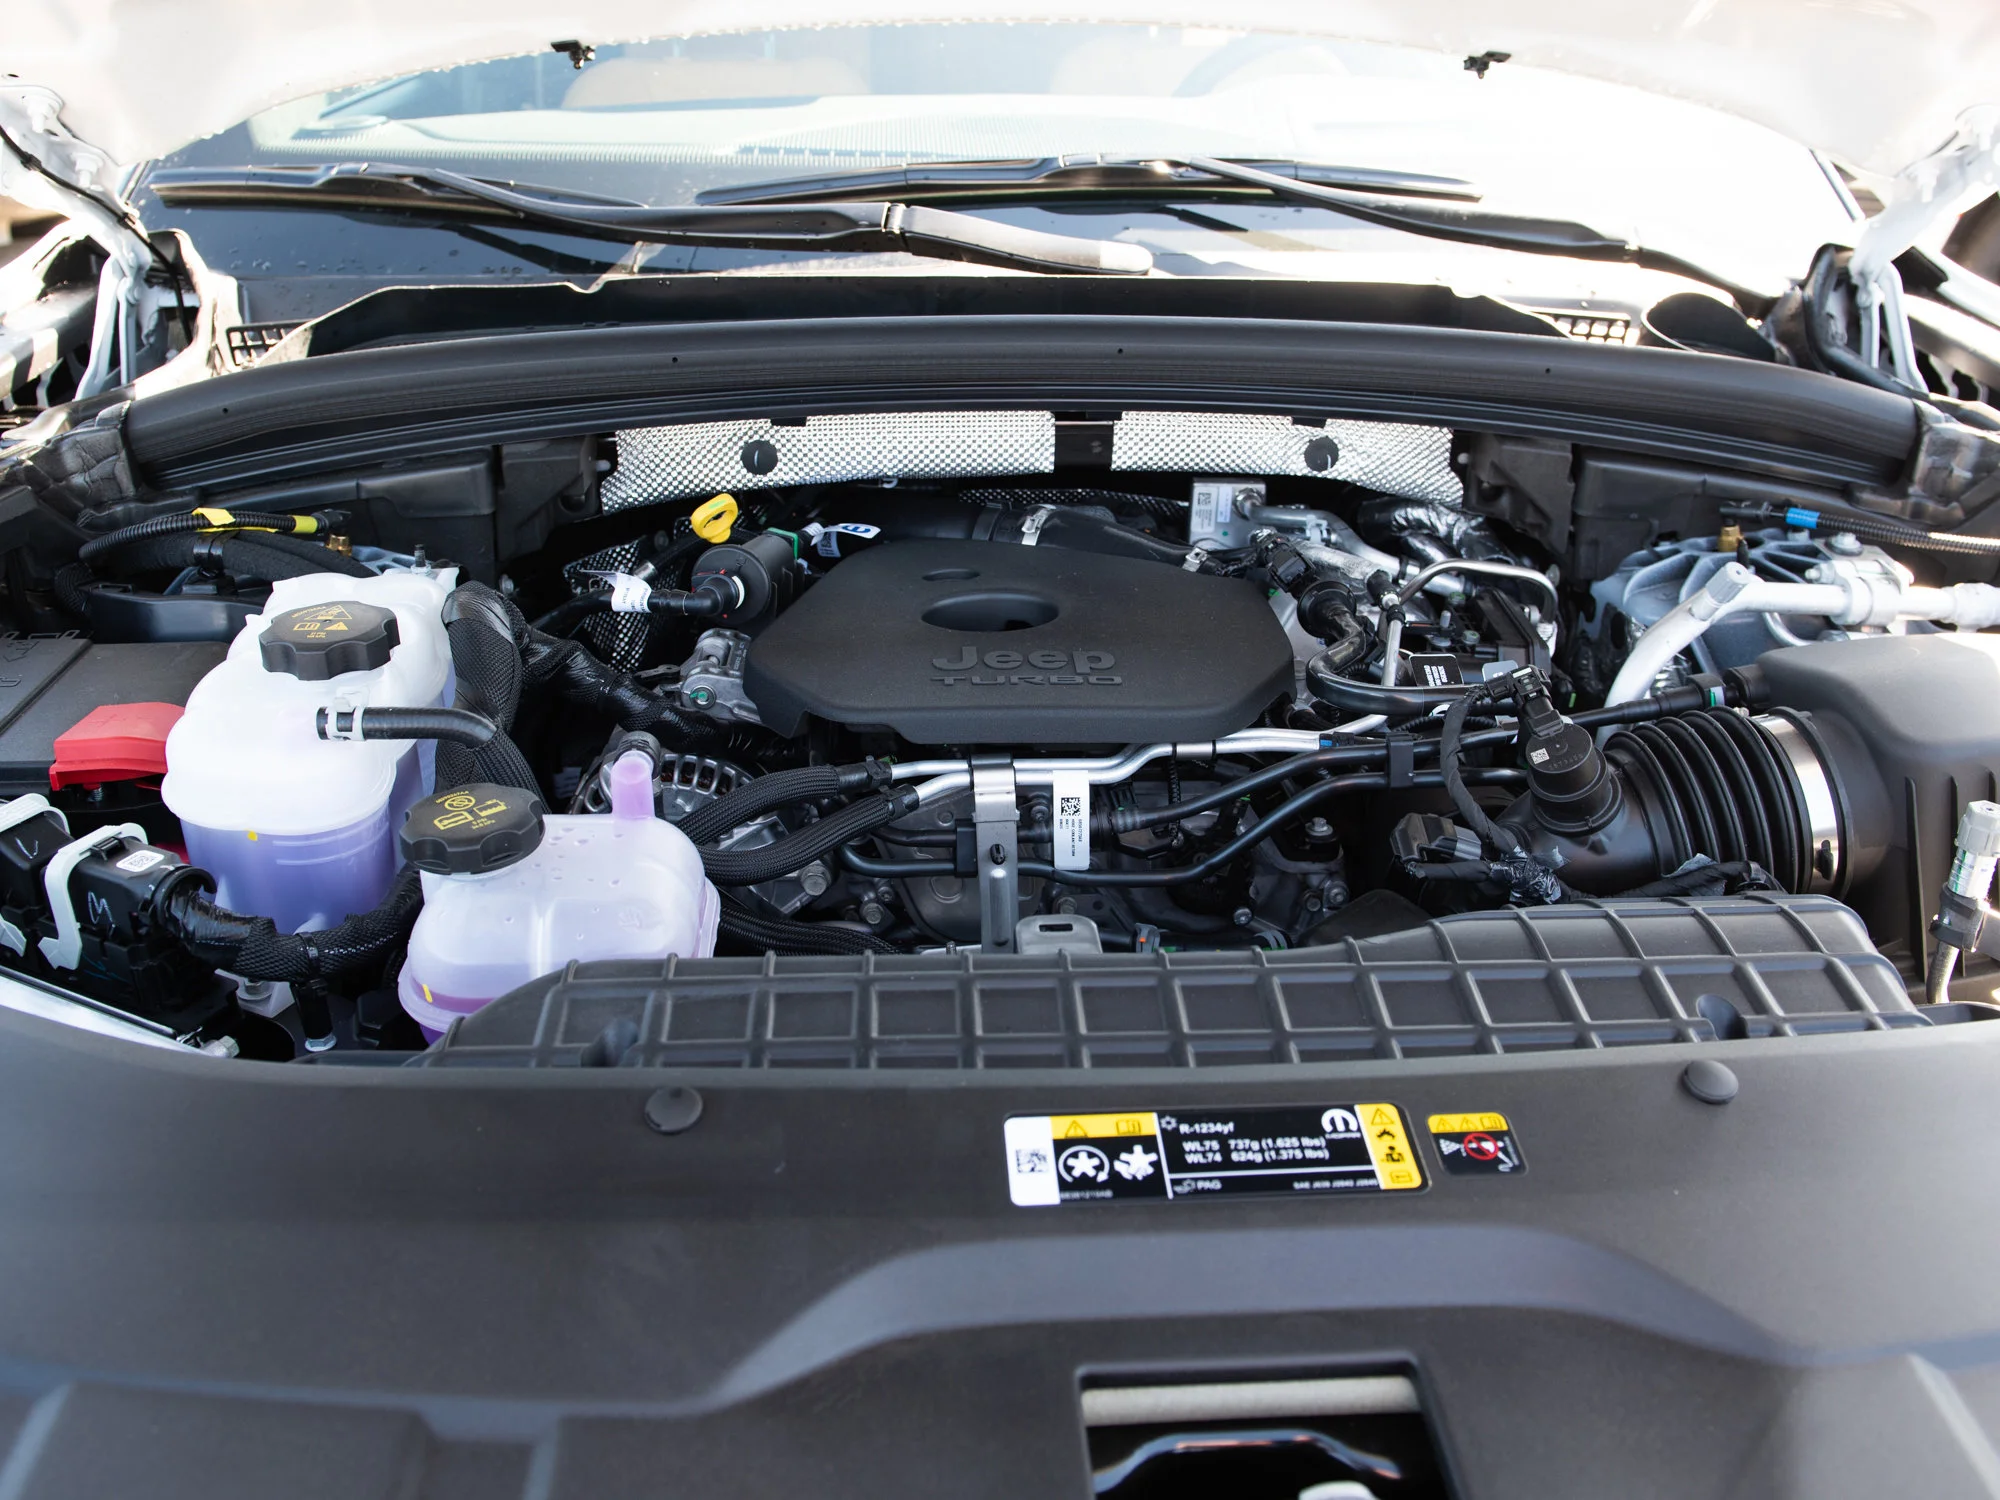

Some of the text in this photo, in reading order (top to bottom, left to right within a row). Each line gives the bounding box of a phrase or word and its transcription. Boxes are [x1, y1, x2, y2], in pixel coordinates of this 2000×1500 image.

[932, 646, 1116, 675] Jeep
[930, 675, 1122, 687] TURBO
[1179, 1121, 1234, 1134] R-1234yf
[1182, 1136, 1326, 1152] WL75 737g (1.625 lbs)
[1185, 1148, 1329, 1164] WL74 624g (1.375 lbs)
[1197, 1181, 1222, 1191] PAG
